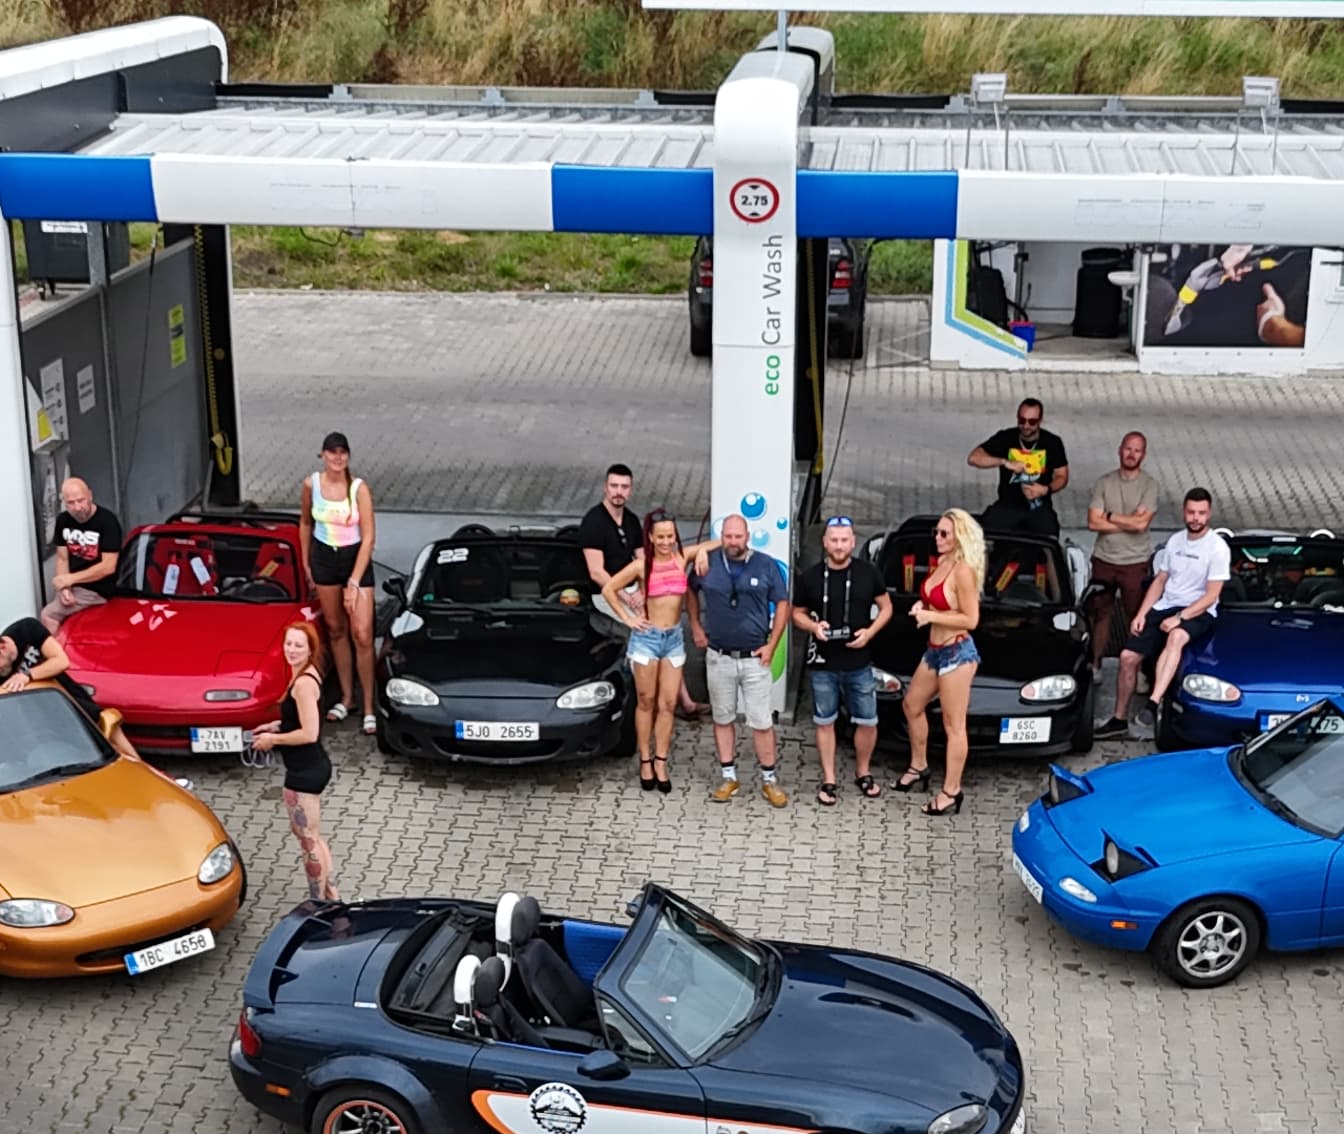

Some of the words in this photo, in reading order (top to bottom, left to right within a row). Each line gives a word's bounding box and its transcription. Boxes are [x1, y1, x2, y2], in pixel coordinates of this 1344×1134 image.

[741, 195, 768, 206] 2.75
[762, 235, 783, 299] Wash
[762, 307, 781, 345] Car
[765, 355, 780, 396] eco
[500, 725, 533, 738] 2655
[140, 948, 164, 967] 1BC
